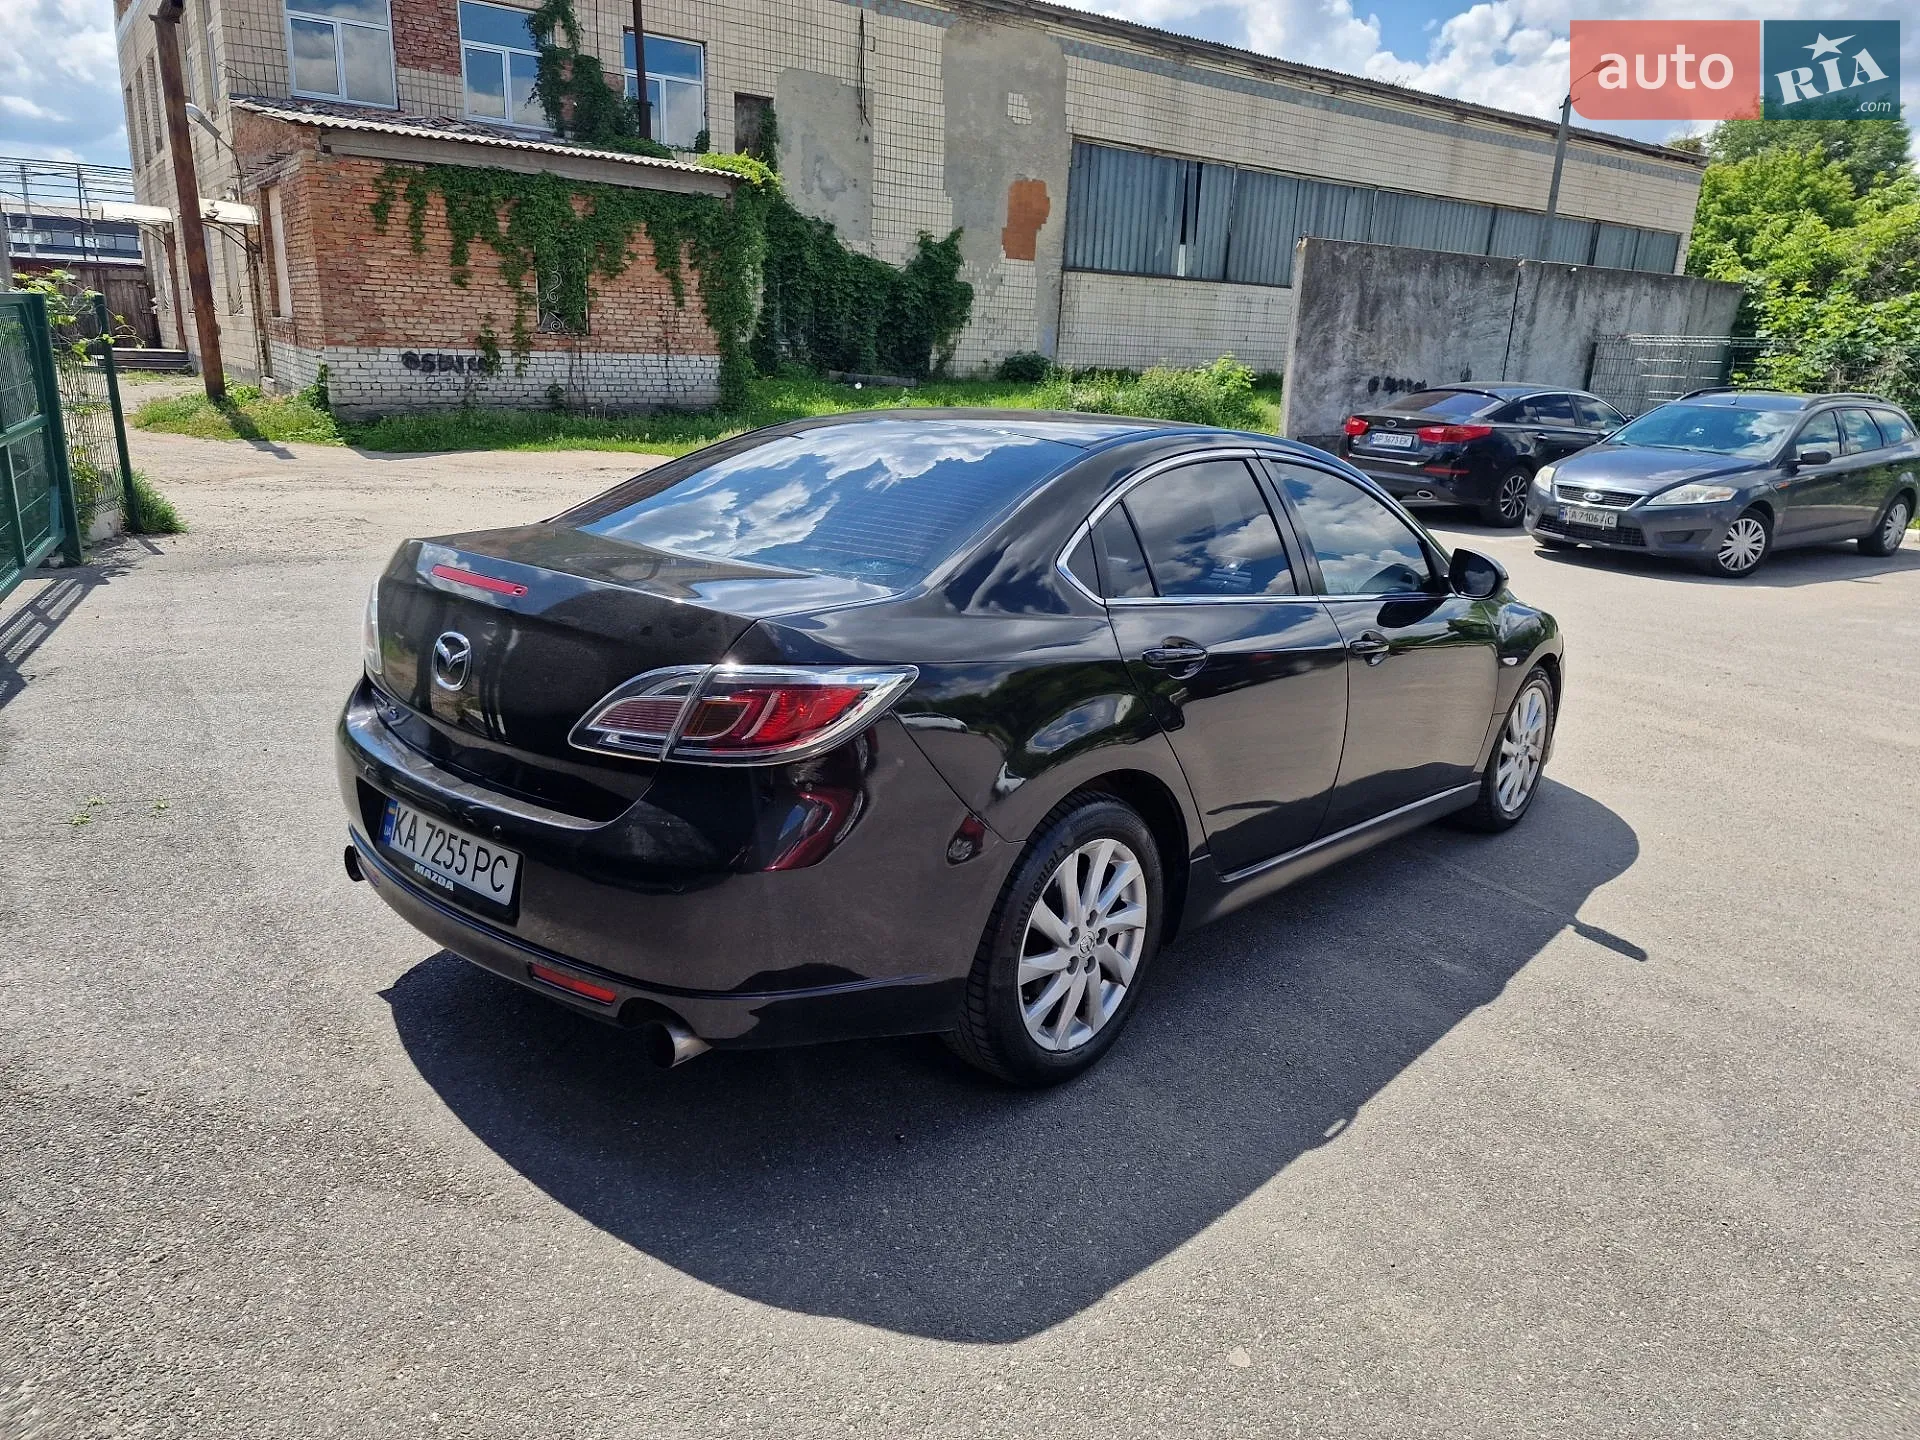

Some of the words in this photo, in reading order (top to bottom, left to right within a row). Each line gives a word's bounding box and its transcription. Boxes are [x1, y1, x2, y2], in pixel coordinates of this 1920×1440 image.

[392, 807, 418, 852] KA
[420, 822, 470, 876] 7255
[471, 845, 509, 893] PC
[414, 863, 455, 891] MAZDA
